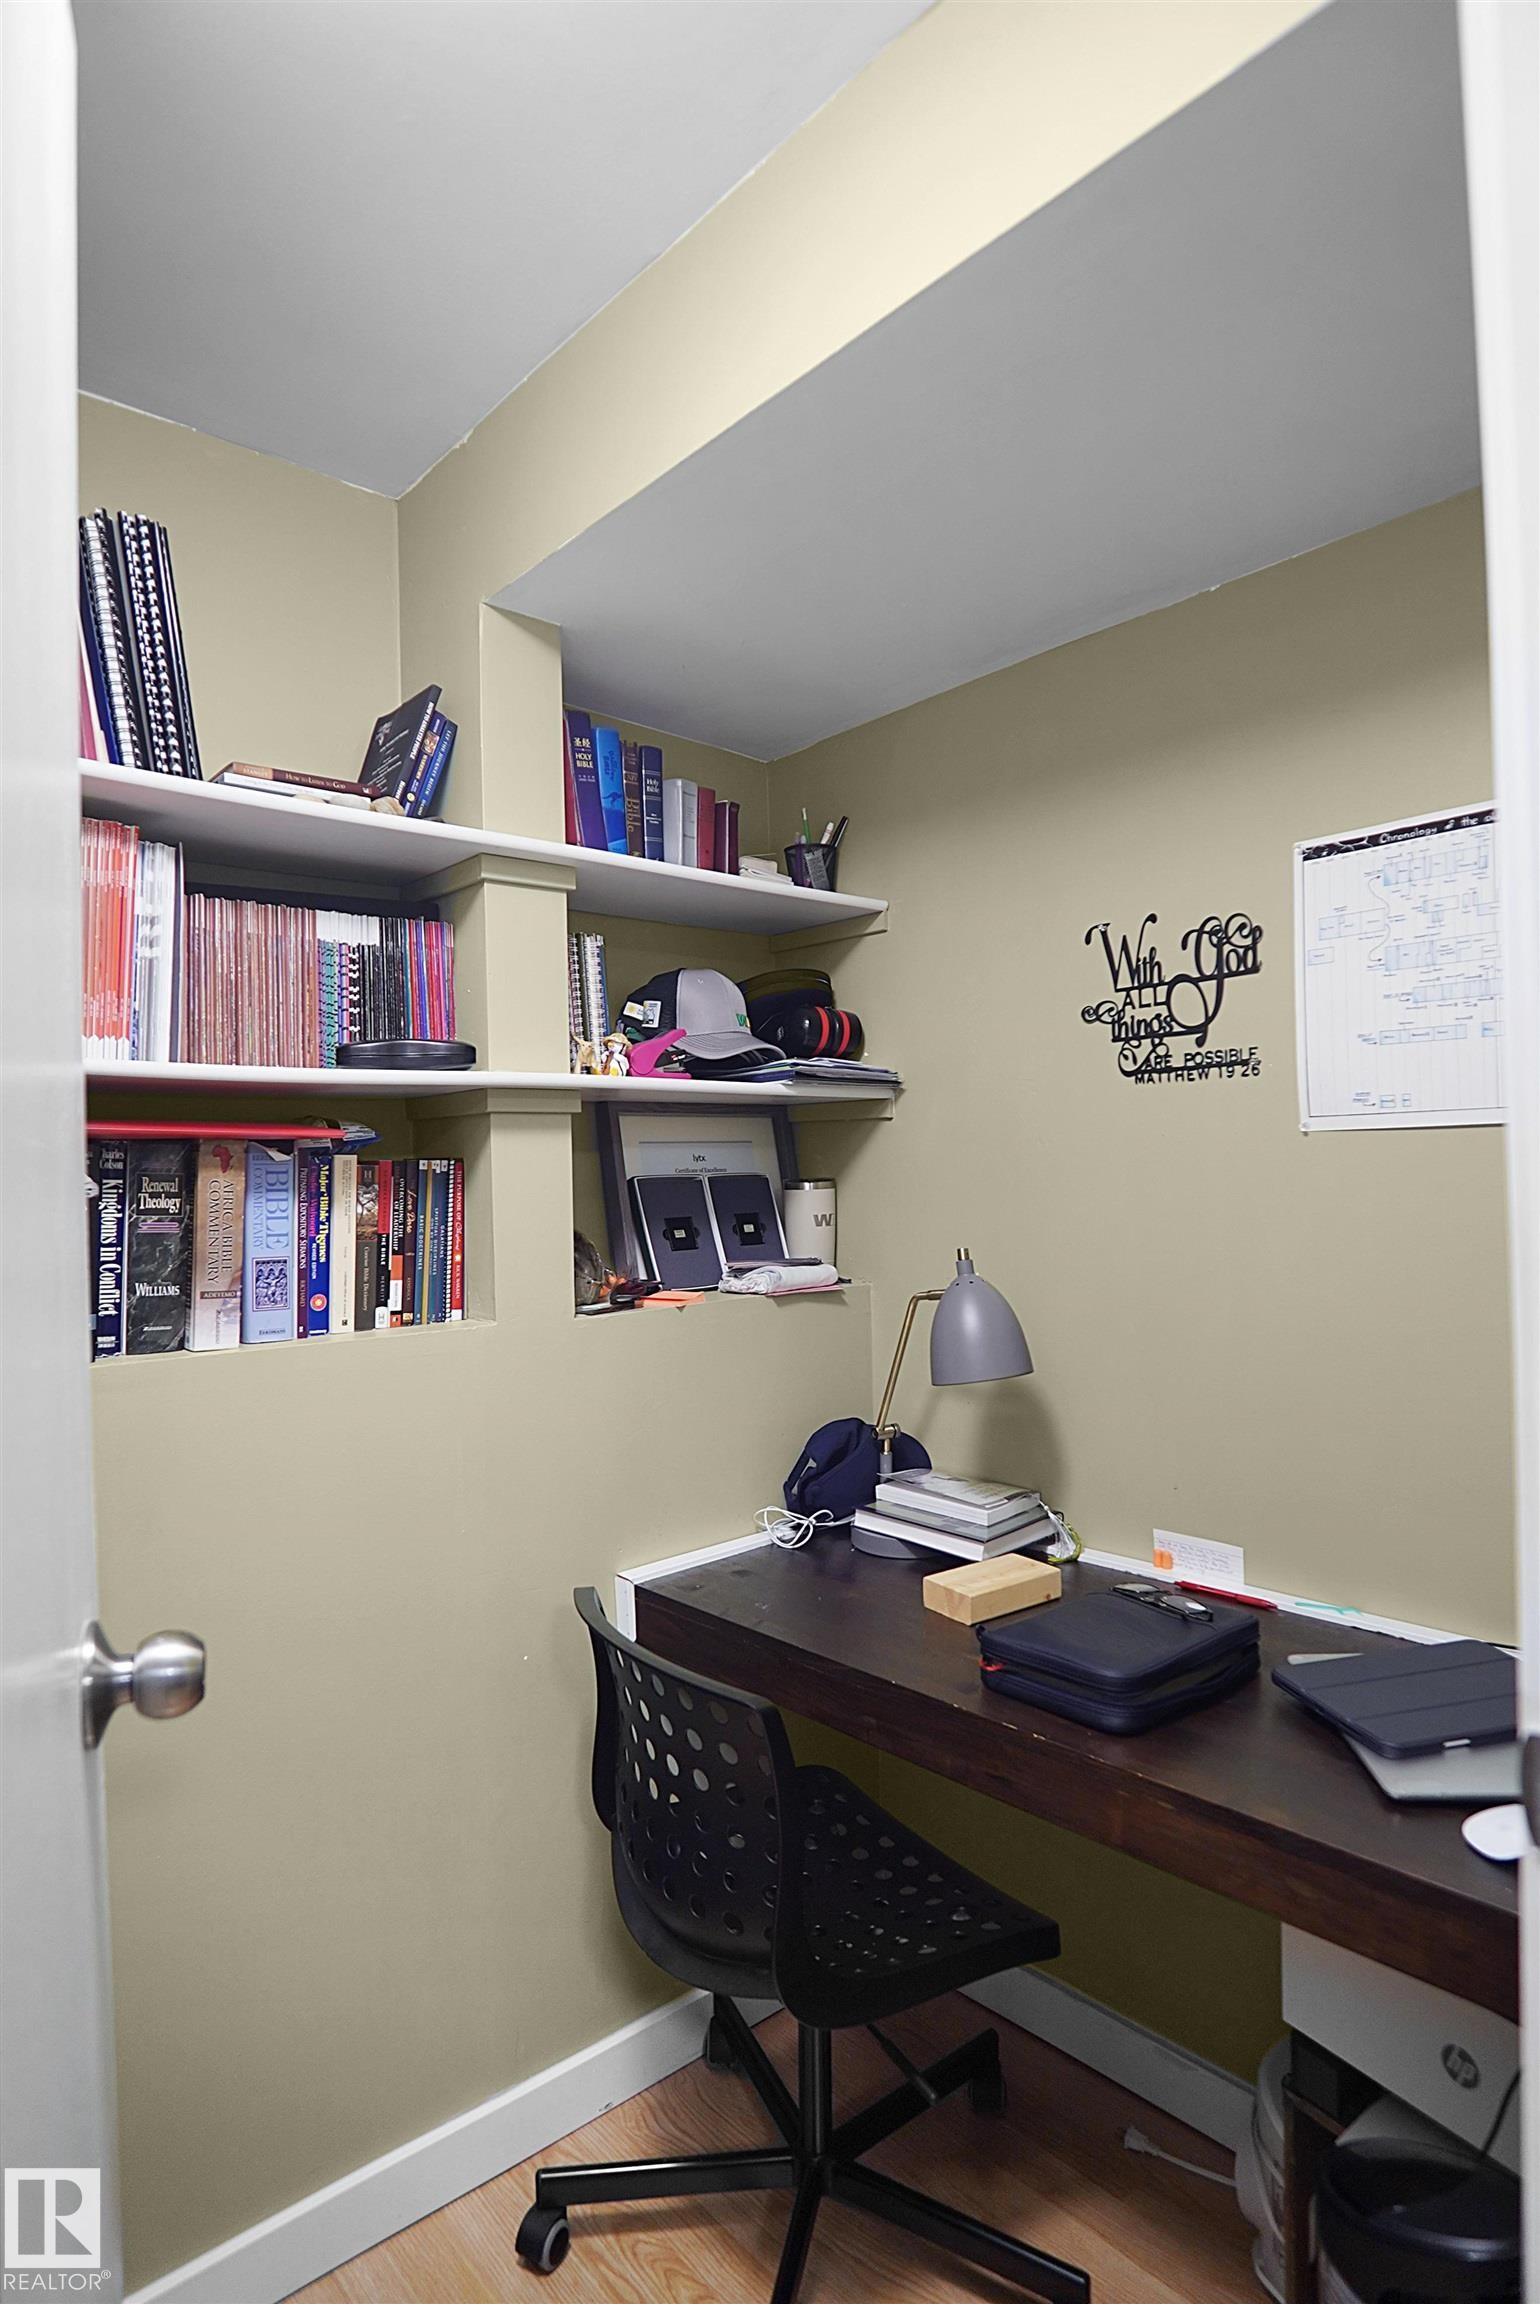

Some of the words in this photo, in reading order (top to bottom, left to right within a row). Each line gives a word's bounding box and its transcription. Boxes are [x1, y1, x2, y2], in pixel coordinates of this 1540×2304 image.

[575, 752, 592, 761] HOLY
[576, 760, 593, 768] BIBLE
[1379, 826, 1437, 844] Chronology
[1461, 813, 1478, 826] the
[1085, 913, 1165, 992] With
[1124, 988, 1168, 1009] ALL
[1144, 1054, 1172, 1069] ARE
[1184, 1047, 1259, 1066] POSSIBLE
[1135, 1069, 1210, 1085] MATTHEW
[1241, 1064, 1261, 1077] 26
[141, 1177, 179, 1193] Renewal
[299, 1167, 308, 1201] PREPARING
[319, 1164, 329, 1196] Major
[98, 1179, 123, 1244] Kingdoms
[138, 1193, 182, 1214] Theology
[222, 1180, 235, 1232] AFRICA
[252, 1167, 264, 1248] COMMENTARY
[265, 1169, 289, 1249] BIBLE
[319, 1196, 329, 1222] Bible
[207, 1179, 221, 1284] COMMENTARY
[299, 1202, 308, 1238] EXPOSITORY
[813, 1213, 834, 1227] W
[100, 1246, 122, 1262] in
[221, 1236, 233, 1272] BIBLE
[299, 1239, 307, 1269] SERMONS
[315, 1222, 329, 1263] Themes
[97, 1263, 121, 1317] Conflict
[135, 1282, 180, 1297] WILLIAMS
